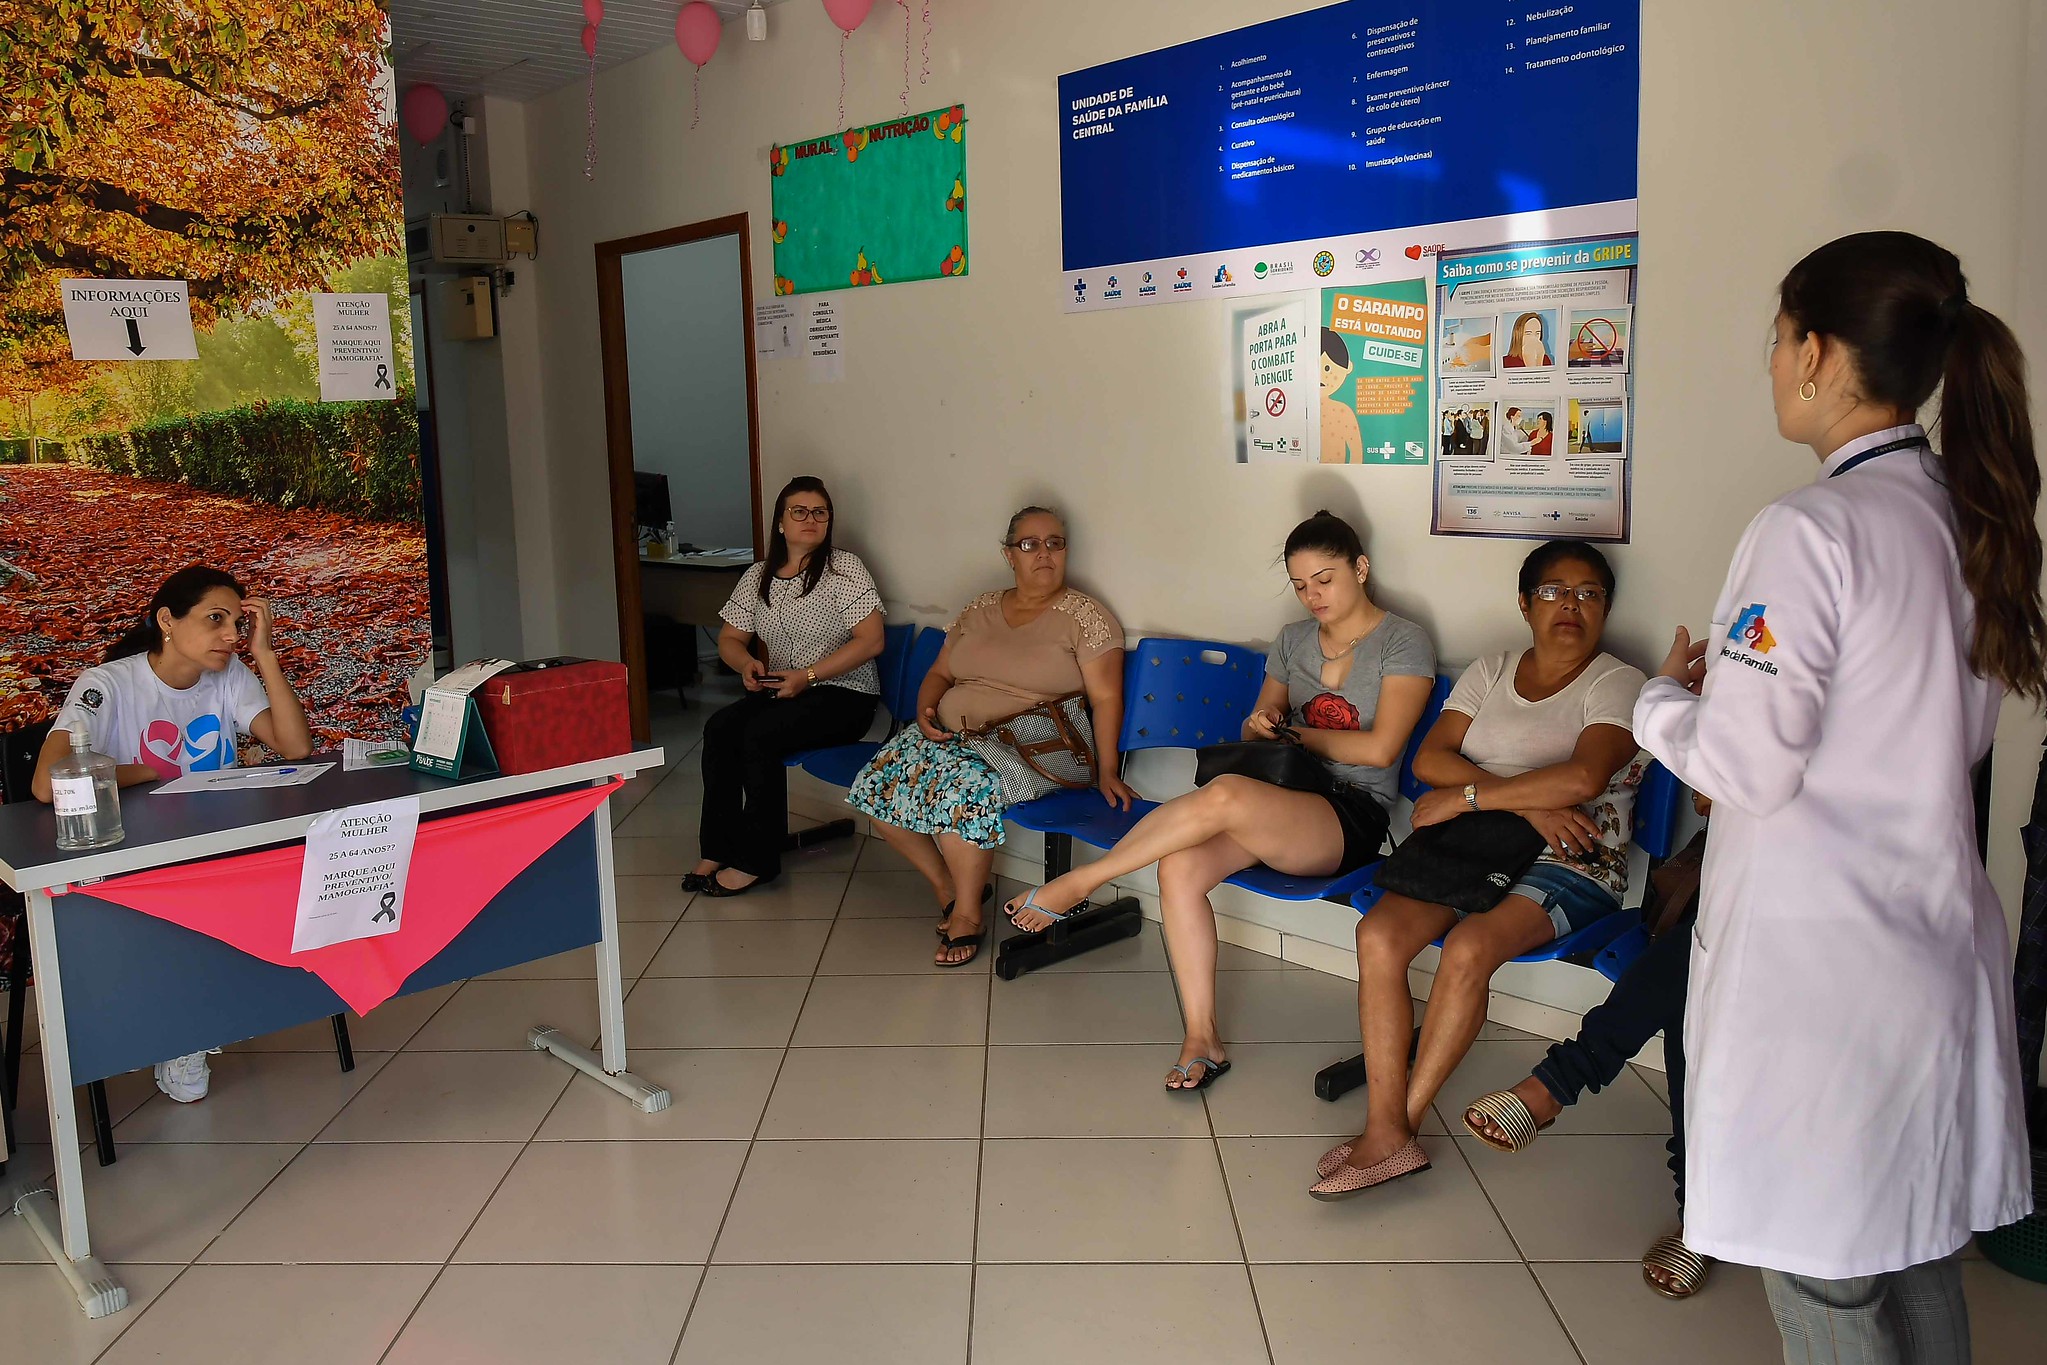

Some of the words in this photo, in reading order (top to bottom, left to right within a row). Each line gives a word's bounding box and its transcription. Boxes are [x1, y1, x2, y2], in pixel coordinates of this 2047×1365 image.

[1526, 5, 1574, 22] Nebulização
[1367, 20, 1409, 36] Dispensação
[1409, 18, 1418, 26] de
[1525, 29, 1579, 46] Planejamento
[1580, 22, 1611, 35] familiar
[1366, 32, 1411, 48] preservativos
[1366, 42, 1415, 58] contraceptivos
[1525, 55, 1569, 70] Tratamento
[1570, 44, 1625, 61] odontológico
[1231, 54, 1267, 68] Acolhimento
[1231, 71, 1284, 88] Acompanhamento
[1284, 69, 1292, 77] da
[1366, 66, 1408, 80] Enfermagem
[1072, 90, 1117, 111] UNIDADE
[1119, 87, 1134, 99] DE
[1231, 88, 1256, 100] gestante
[1261, 85, 1269, 93] do
[1270, 81, 1285, 90] bebê
[1231, 97, 1259, 110] (pré-natal
[1264, 88, 1302, 104] puericultura)
[1366, 91, 1388, 102] Exame
[1388, 85, 1424, 99] preventivo
[1425, 80, 1450, 91] (câncer
[1072, 108, 1106, 125] SAÚDE
[1108, 106, 1123, 117] DA
[1125, 94, 1168, 114] FAMÍLIA
[1366, 105, 1375, 113] de
[1375, 103, 1390, 111] colo
[1391, 100, 1399, 108] de
[1400, 96, 1421, 107] útero)
[1231, 119, 1256, 129] Consulta
[1256, 112, 1295, 124] odontológica
[1366, 127, 1387, 136] Grupo
[1387, 123, 1396, 131] de
[1396, 118, 1429, 130] educação
[795, 140, 833, 160] MURAL
[869, 115, 930, 143] NUTRIÇÃO
[1073, 122, 1115, 140] CENTRAL
[1231, 140, 1256, 150] Curativo
[1366, 136, 1386, 146] saúde
[1231, 157, 1267, 170] Dispensação
[1366, 156, 1403, 168] Imunização
[1404, 150, 1433, 163] (vacinas)
[1231, 168, 1273, 180] medicamentos
[1273, 164, 1295, 173] básicos
[1423, 243, 1446, 253] SAÚDE
[1270, 261, 1294, 269] BRASIL
[1443, 263, 1472, 279] Saiba
[1474, 263, 1503, 275] como
[1505, 260, 1518, 271] se
[1520, 253, 1572, 272] prevenir
[1574, 251, 1590, 263] da
[1593, 244, 1631, 262] GRIPE
[71, 289, 181, 305] INFORMAÇÕES
[336, 300, 370, 309] ATENÇÃO
[110, 306, 149, 318] AQUI
[1338, 298, 1349, 311] O
[1353, 299, 1425, 321] SARAMPO
[1258, 320, 1279, 338] ABRA
[1280, 318, 1286, 331] A
[1335, 318, 1361, 331] ESTÁ
[1365, 322, 1422, 340] VOLTANDO
[1249, 339, 1273, 356] PORTA
[1275, 332, 1297, 349] PARA
[1251, 359, 1257, 371] O
[1257, 350, 1295, 369] COMBATE
[1368, 346, 1418, 362] CUIDE-SE
[1254, 372, 1260, 387] À
[1261, 369, 1293, 386] DENGUE
[1739, 653, 1778, 676] Família
[340, 813, 392, 828] ATENÇÃO
[340, 825, 389, 838] MULHER
[329, 851, 339, 861] 25
[339, 851, 347, 859] A
[348, 849, 359, 857] 64
[360, 844, 396, 857] ANOS??
[323, 867, 369, 882] MARQUE
[370, 862, 396, 875] AQUI
[324, 872, 393, 892] PREVENTIVO/
